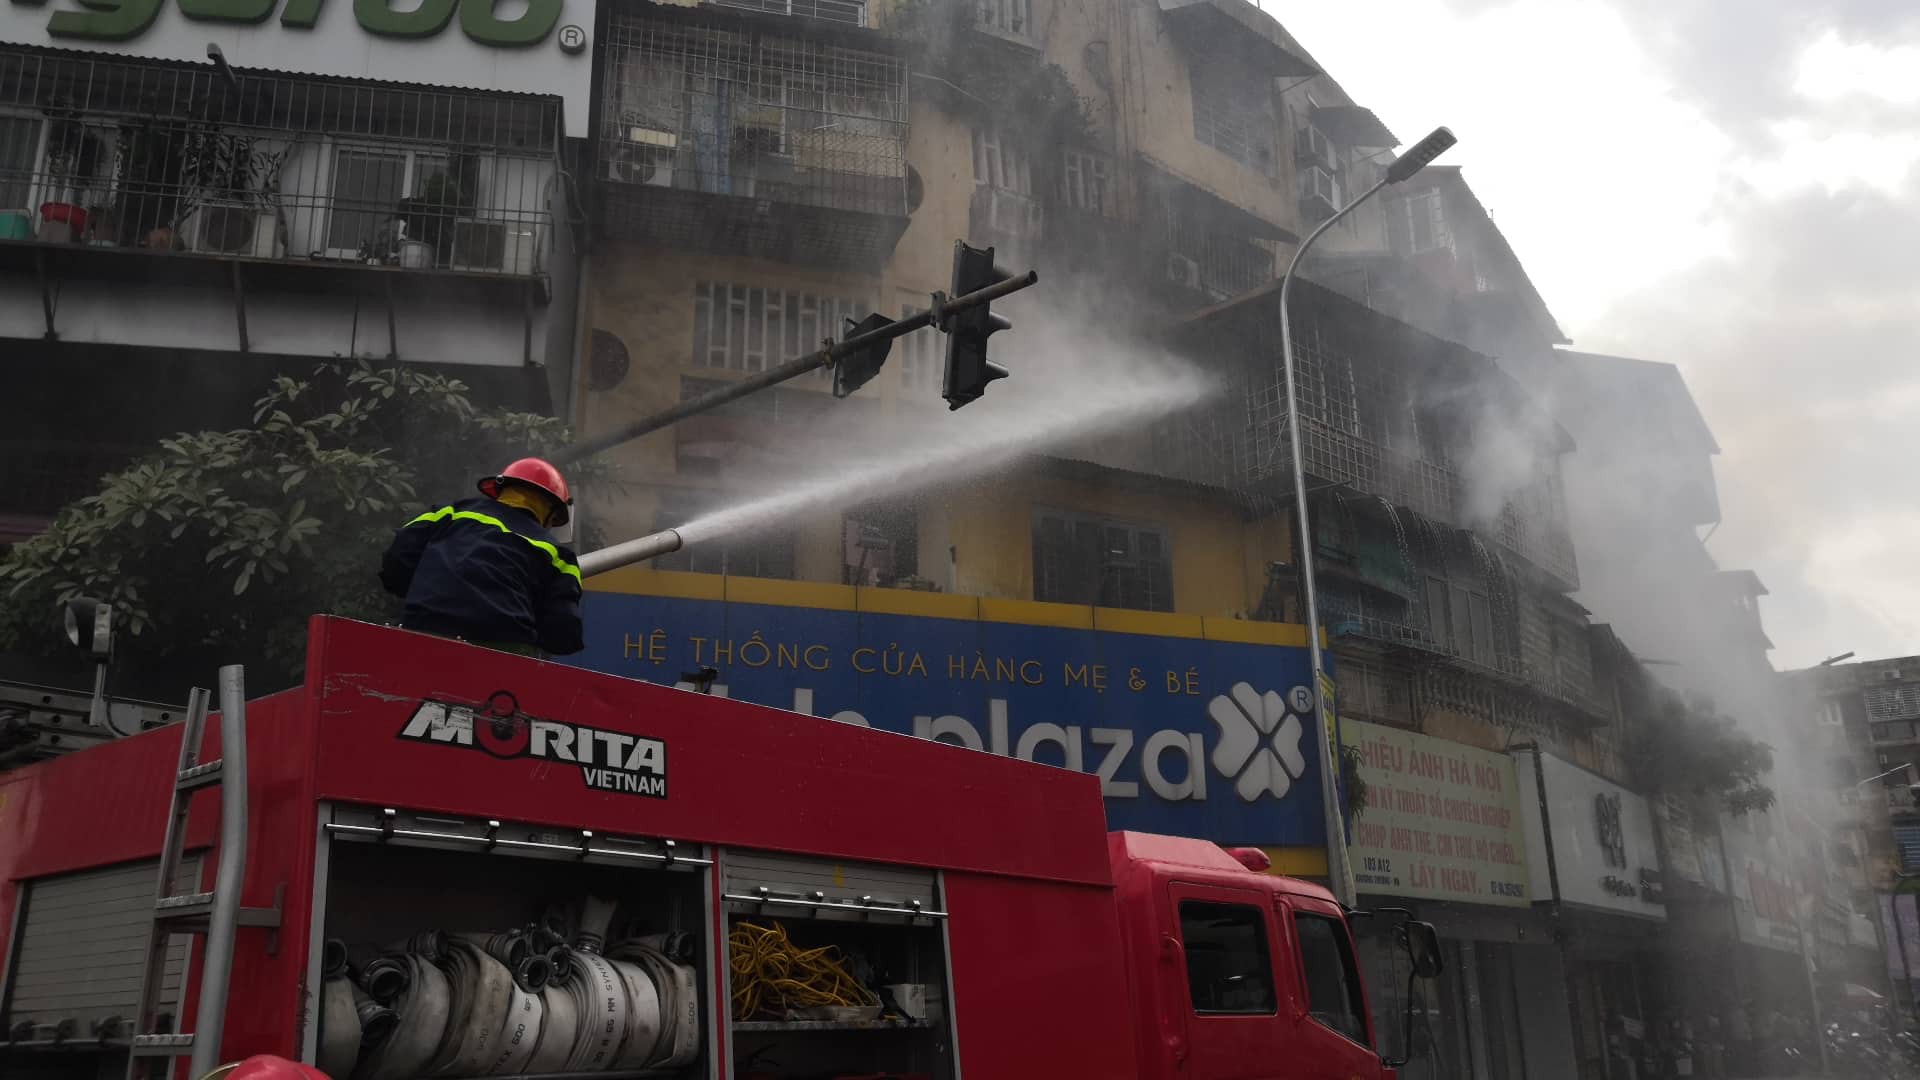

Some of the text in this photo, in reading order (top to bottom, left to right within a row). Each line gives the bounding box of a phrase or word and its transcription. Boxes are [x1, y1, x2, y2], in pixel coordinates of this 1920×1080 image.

[624, 629, 1201, 696] HỆ THỐNG CỬA HÀNG MẸ & BÉ
[401, 692, 666, 776] MORITA
[583, 766, 666, 797] VIETNAM
[1363, 856, 1391, 872] 103 A12
